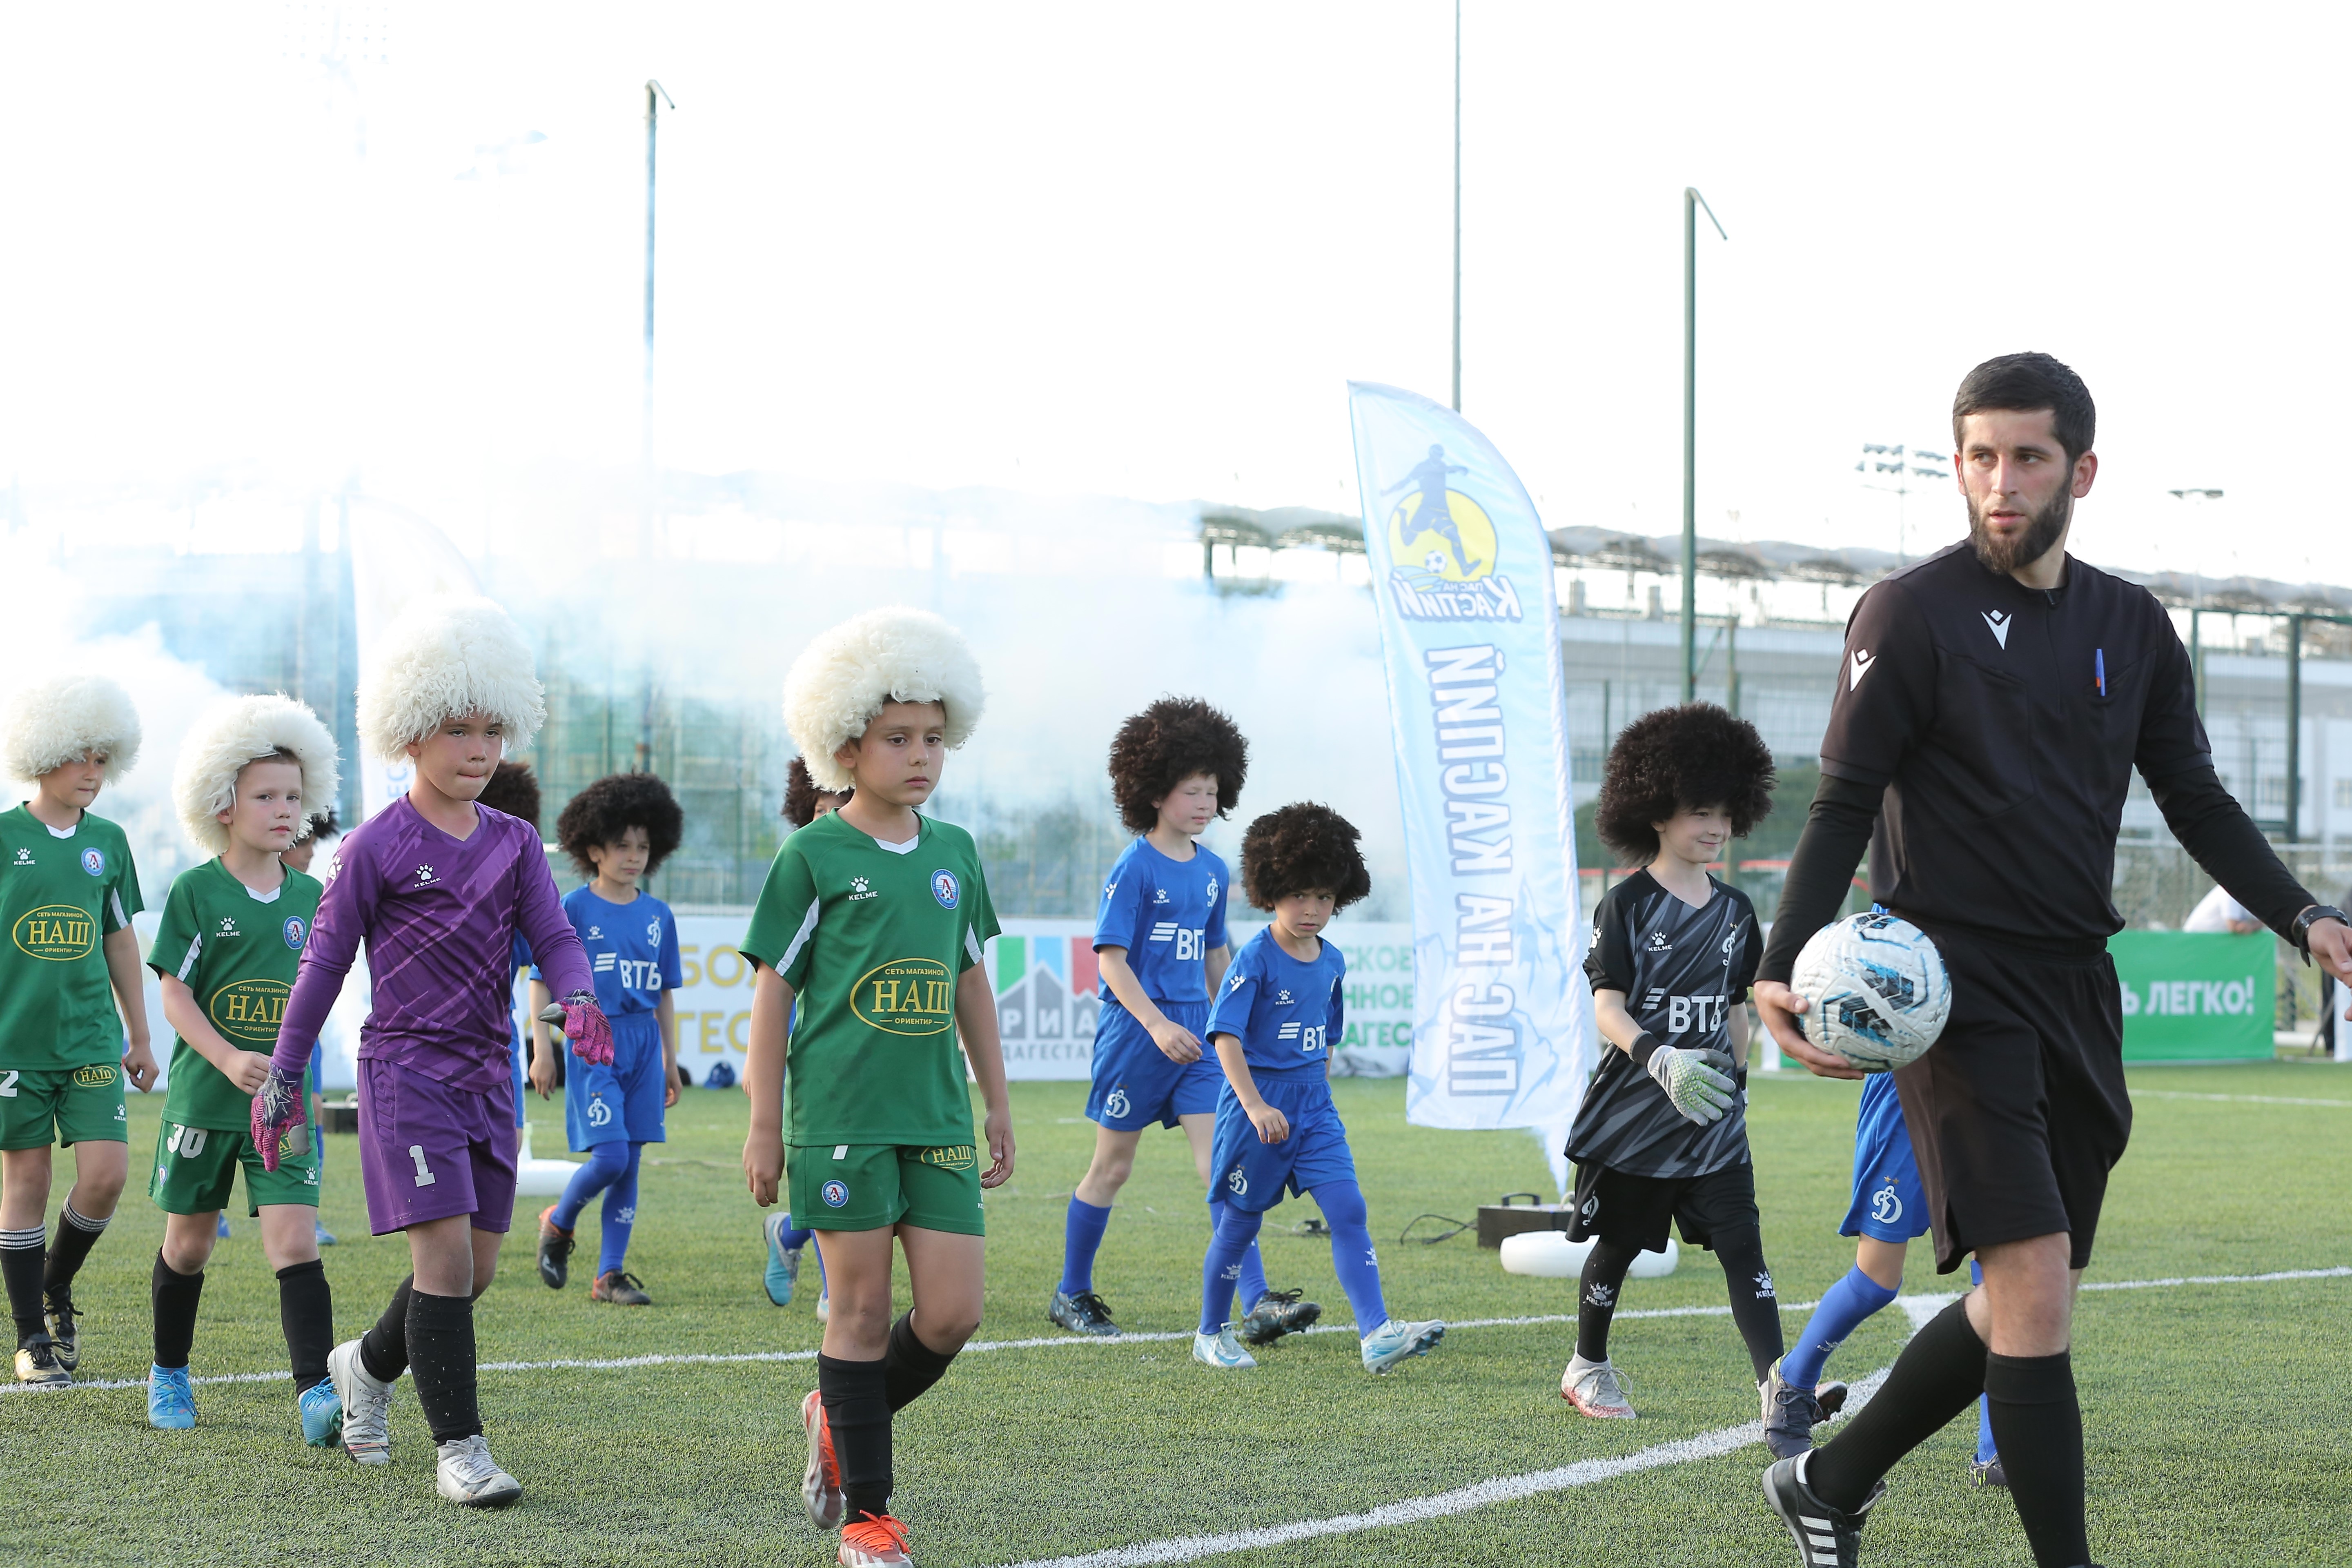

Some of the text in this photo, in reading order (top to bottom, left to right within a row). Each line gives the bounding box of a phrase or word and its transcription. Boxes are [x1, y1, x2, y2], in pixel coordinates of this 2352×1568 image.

[414, 877, 441, 888] KELME
[849, 891, 878, 901] KELME
[27, 920, 90, 946] НАШ
[1176, 928, 1205, 961] ВТ
[1648, 944, 1673, 952] KELME
[619, 959, 662, 991] ВТБ
[871, 980, 950, 1015] НАШ
[2145, 975, 2255, 1016] ЛЕГКО!
[1002, 1009, 1097, 1036] РИА
[1302, 1024, 1326, 1052] ВТ
[1002, 1044, 1094, 1062] ДАГЕСТА
[167, 1123, 208, 1158] 30
[931, 1145, 971, 1163] НАШ
[408, 1145, 436, 1187] 1
